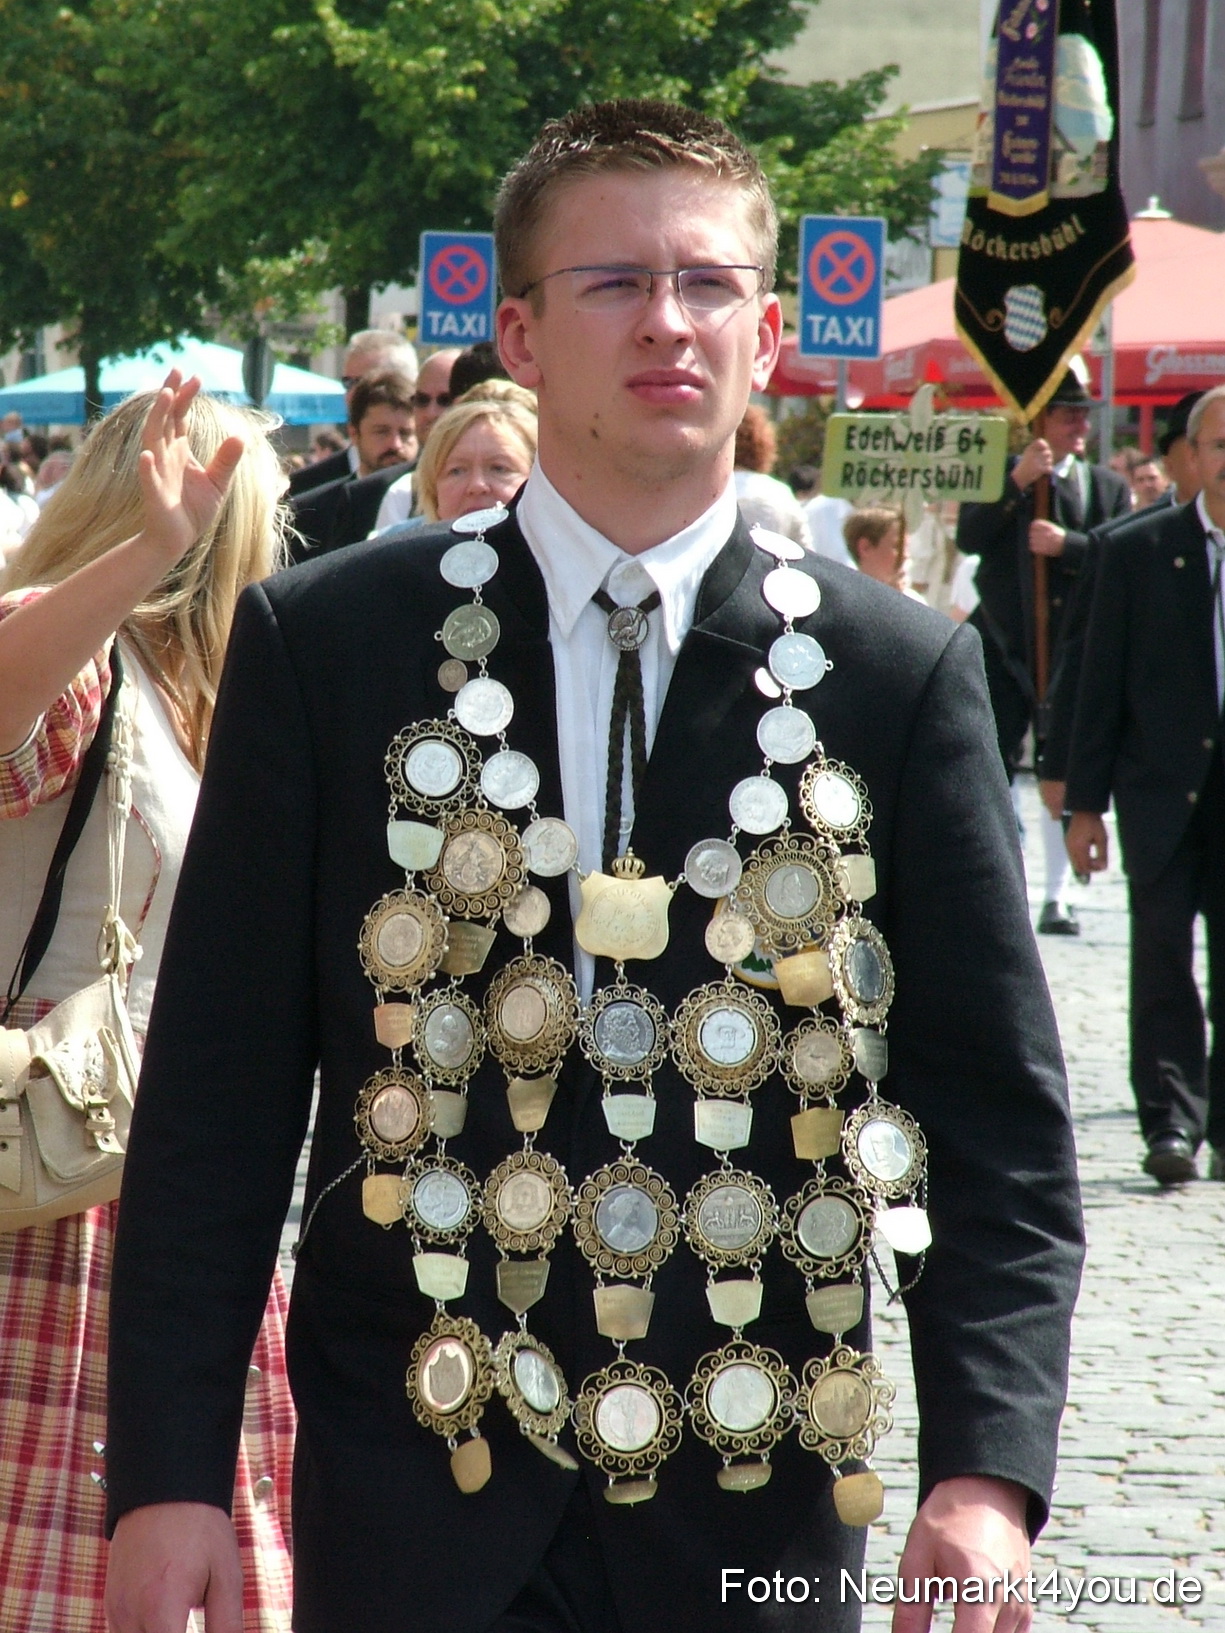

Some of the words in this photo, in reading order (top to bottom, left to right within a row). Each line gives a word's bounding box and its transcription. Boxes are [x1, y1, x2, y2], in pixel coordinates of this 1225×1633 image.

[428, 312, 486, 337] TAXI
[808, 314, 875, 347] TAXI
[845, 425, 946, 453] Edelweiß
[957, 428, 987, 454] 64
[841, 463, 984, 489] Röckersbühl
